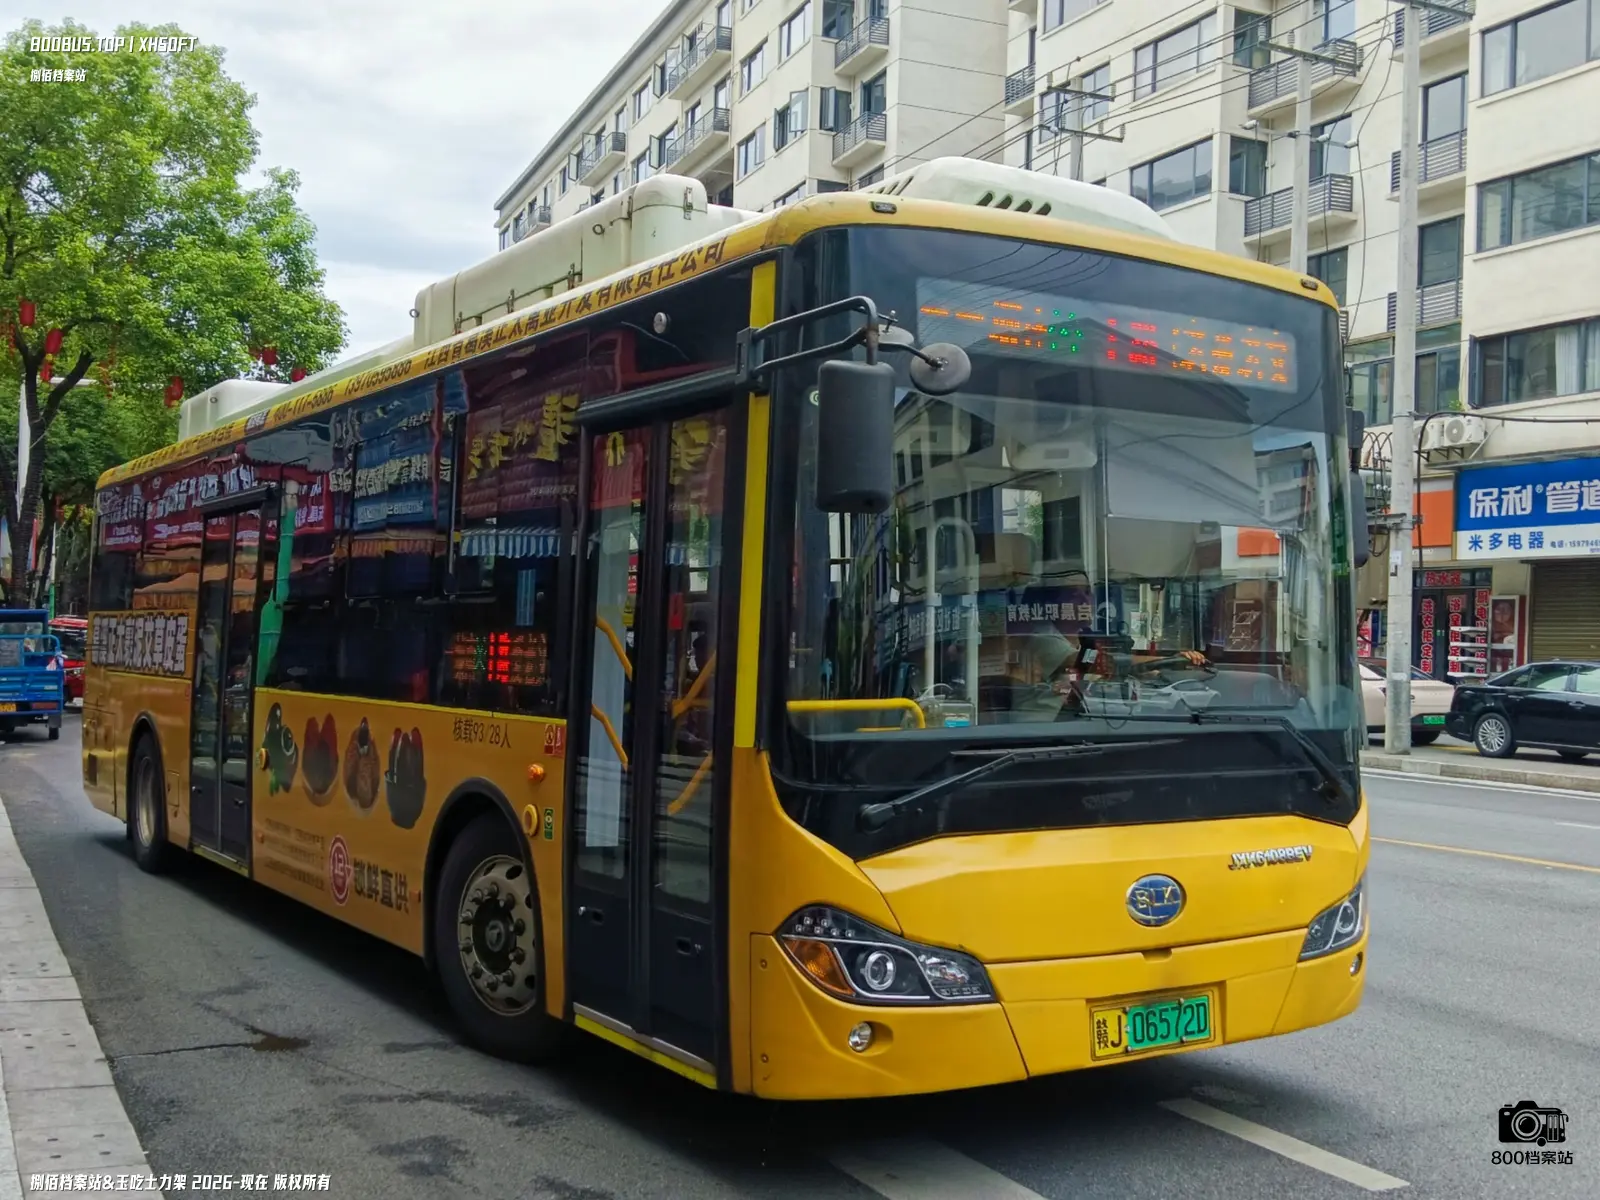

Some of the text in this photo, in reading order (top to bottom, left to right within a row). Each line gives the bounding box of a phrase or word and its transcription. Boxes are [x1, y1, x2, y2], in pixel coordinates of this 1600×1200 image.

[1469, 531, 1545, 552] 米多电器
[1425, 571, 1461, 587] 热水器
[1421, 598, 1434, 674] 洗衣柜定制
[452, 717, 512, 749] 核载93/28人
